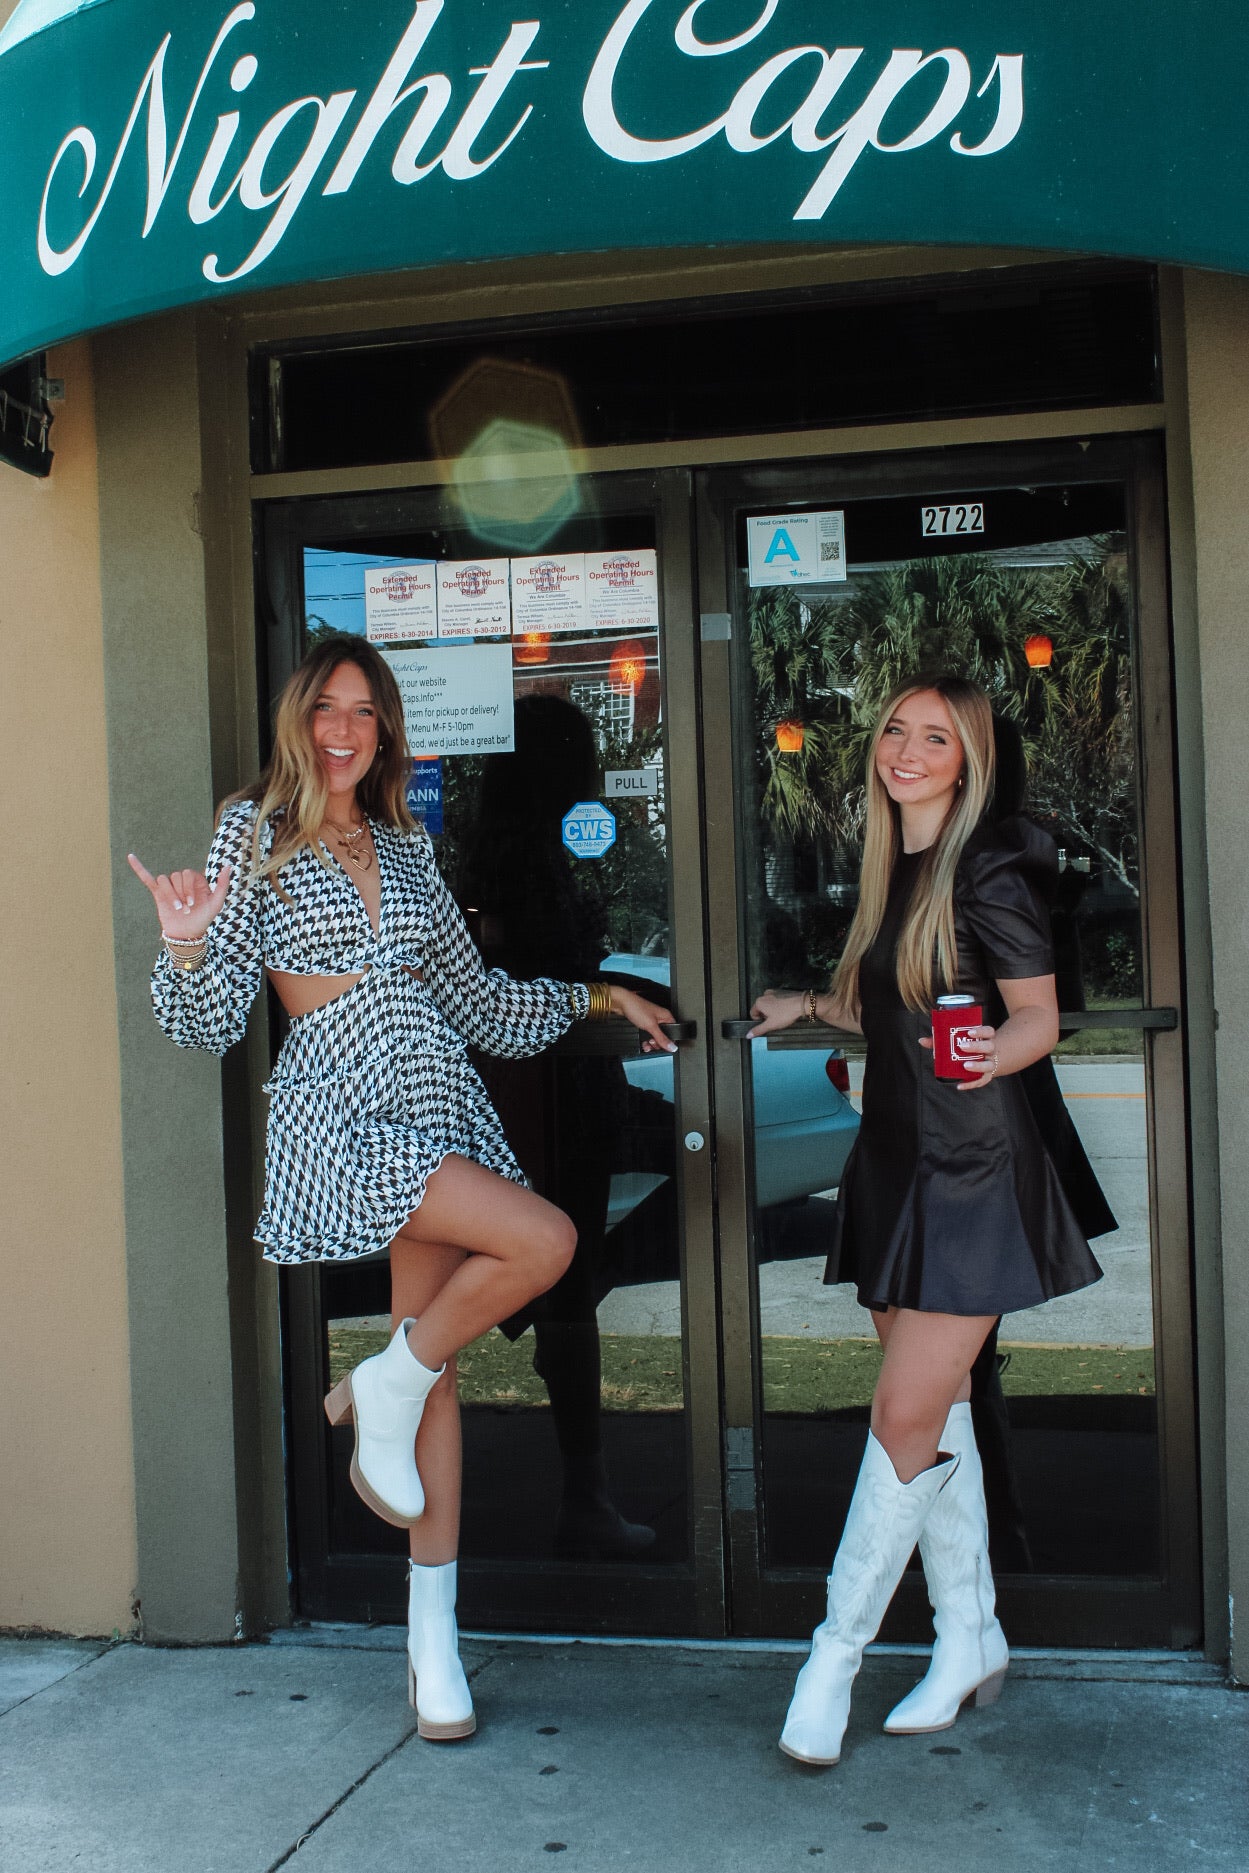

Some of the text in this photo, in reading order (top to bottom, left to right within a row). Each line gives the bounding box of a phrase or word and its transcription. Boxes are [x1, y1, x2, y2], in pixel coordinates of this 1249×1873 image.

[37, 0, 1023, 283] Night Caps
[926, 505, 982, 534] 2722
[764, 528, 800, 563] A
[530, 566, 565, 574] Extended
[603, 561, 640, 570] Extended
[456, 570, 490, 578] Extended
[590, 571, 628, 579] Operating
[383, 576, 417, 584] Extended
[443, 580, 479, 589] Operating
[516, 576, 554, 585] Operating
[370, 585, 406, 594] Operating
[410, 662, 428, 674] Caps
[406, 680, 417, 688] our
[420, 677, 446, 686] website
[408, 708, 423, 718] item
[425, 708, 435, 717] for
[436, 707, 458, 718] pickup
[470, 704, 499, 716] delivery!
[412, 724, 430, 733] Menu
[433, 722, 446, 732] M-F
[448, 722, 474, 732] 5-10pm
[409, 738, 426, 748] food,
[446, 737, 458, 749] just
[460, 736, 469, 745] be
[477, 736, 494, 747] great
[616, 778, 648, 789] PULL
[406, 788, 438, 802] ANN
[565, 820, 612, 840] CWS
